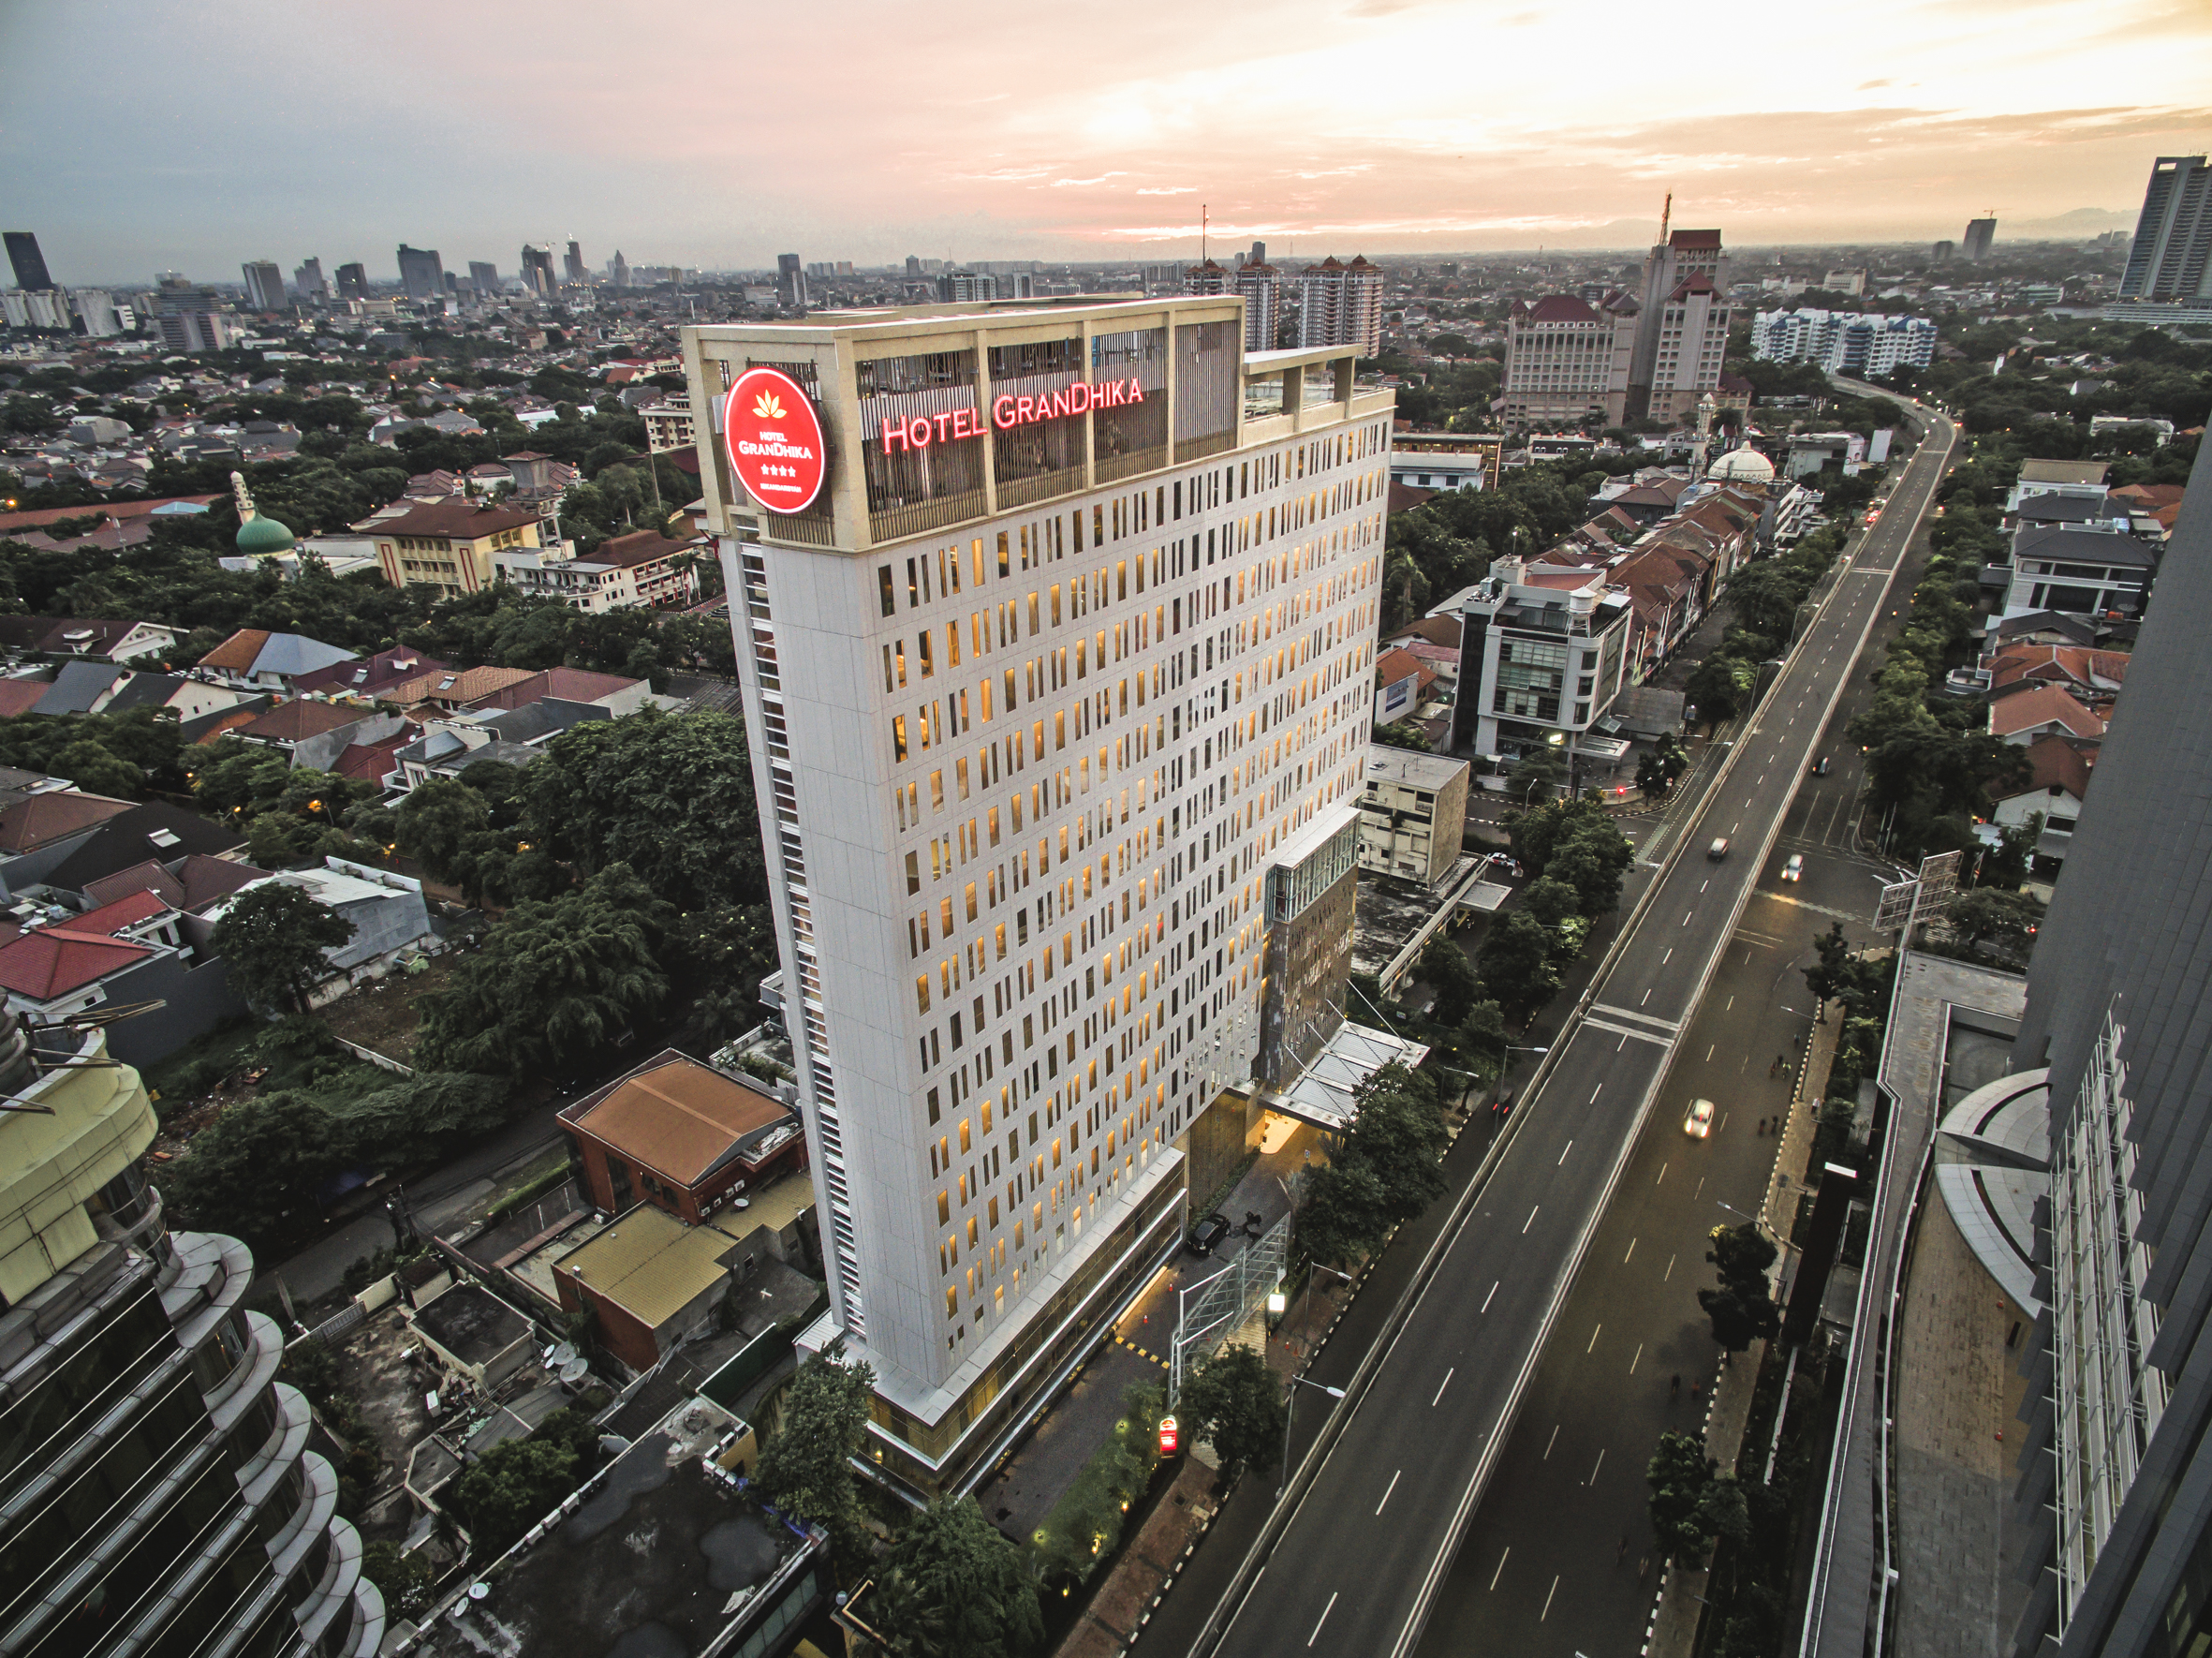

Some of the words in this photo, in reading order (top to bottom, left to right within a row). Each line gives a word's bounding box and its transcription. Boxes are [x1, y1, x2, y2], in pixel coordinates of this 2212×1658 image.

[882, 407, 988, 454] HOTEL
[993, 377, 1143, 430] GRANDHIKA
[759, 431, 788, 442] HOTEL
[738, 440, 813, 459] GRANDHIKA
